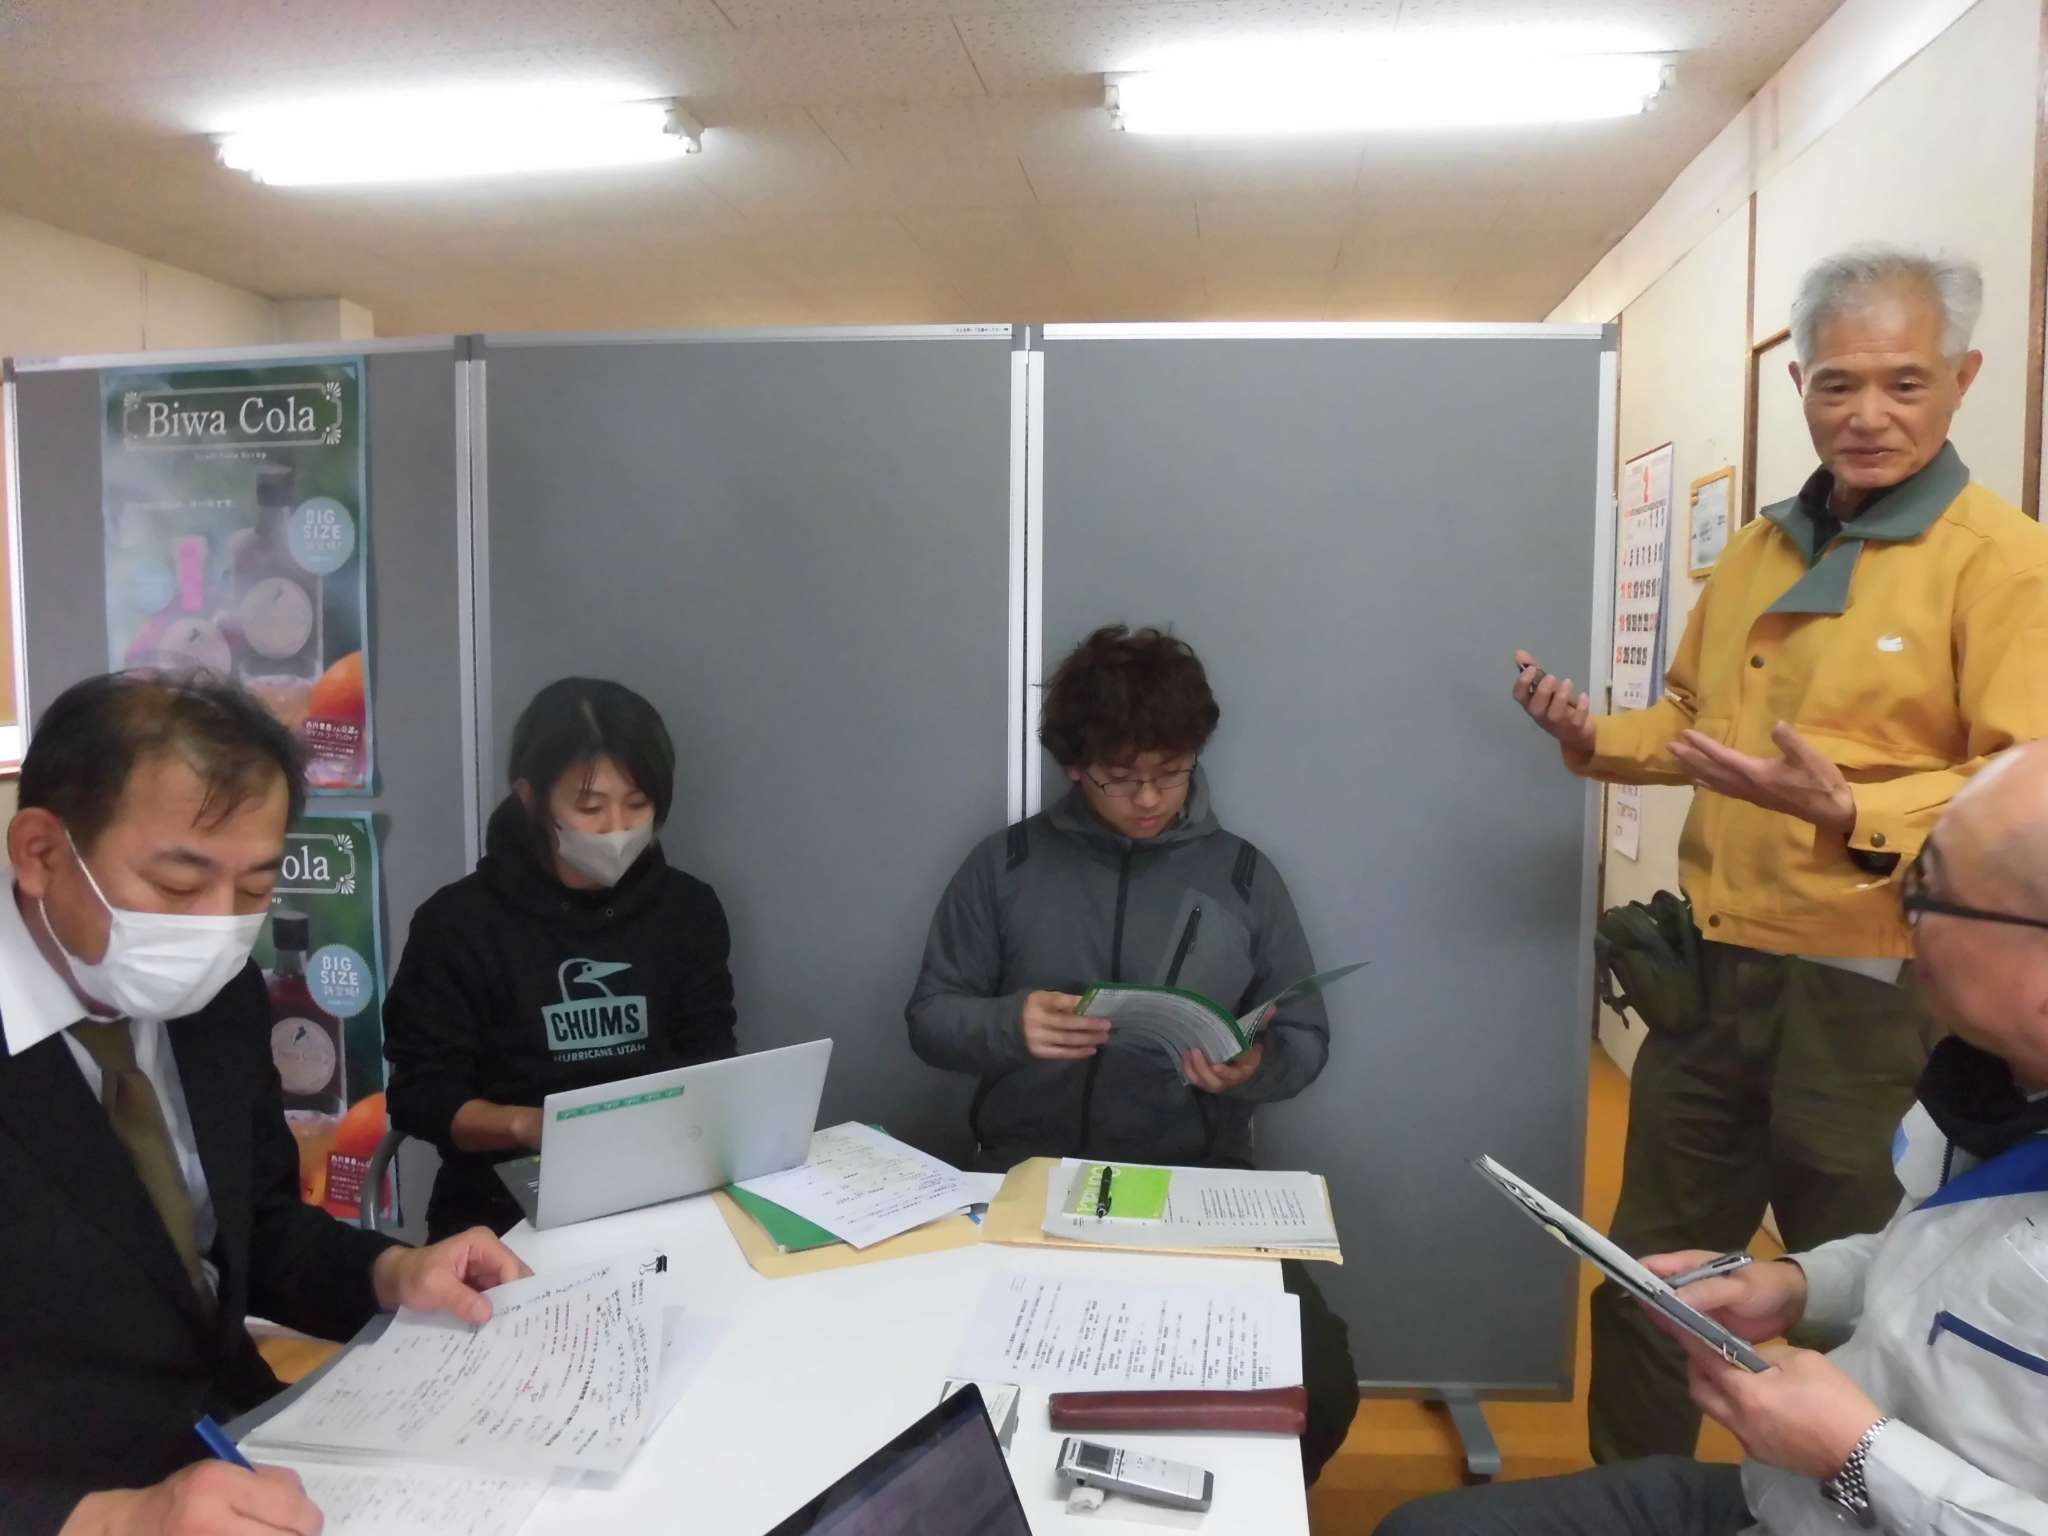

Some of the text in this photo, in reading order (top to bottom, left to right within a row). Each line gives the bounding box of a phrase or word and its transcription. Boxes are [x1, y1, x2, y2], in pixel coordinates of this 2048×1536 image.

[146, 396, 316, 437] Biwa Cola
[305, 509, 335, 524] BIG
[303, 524, 341, 540] SIZE
[282, 845, 331, 881] ola
[322, 956, 352, 971] BIG
[320, 970, 359, 986] SIZE
[550, 1003, 640, 1042] CHUMS
[617, 1043, 646, 1055] UTAH
